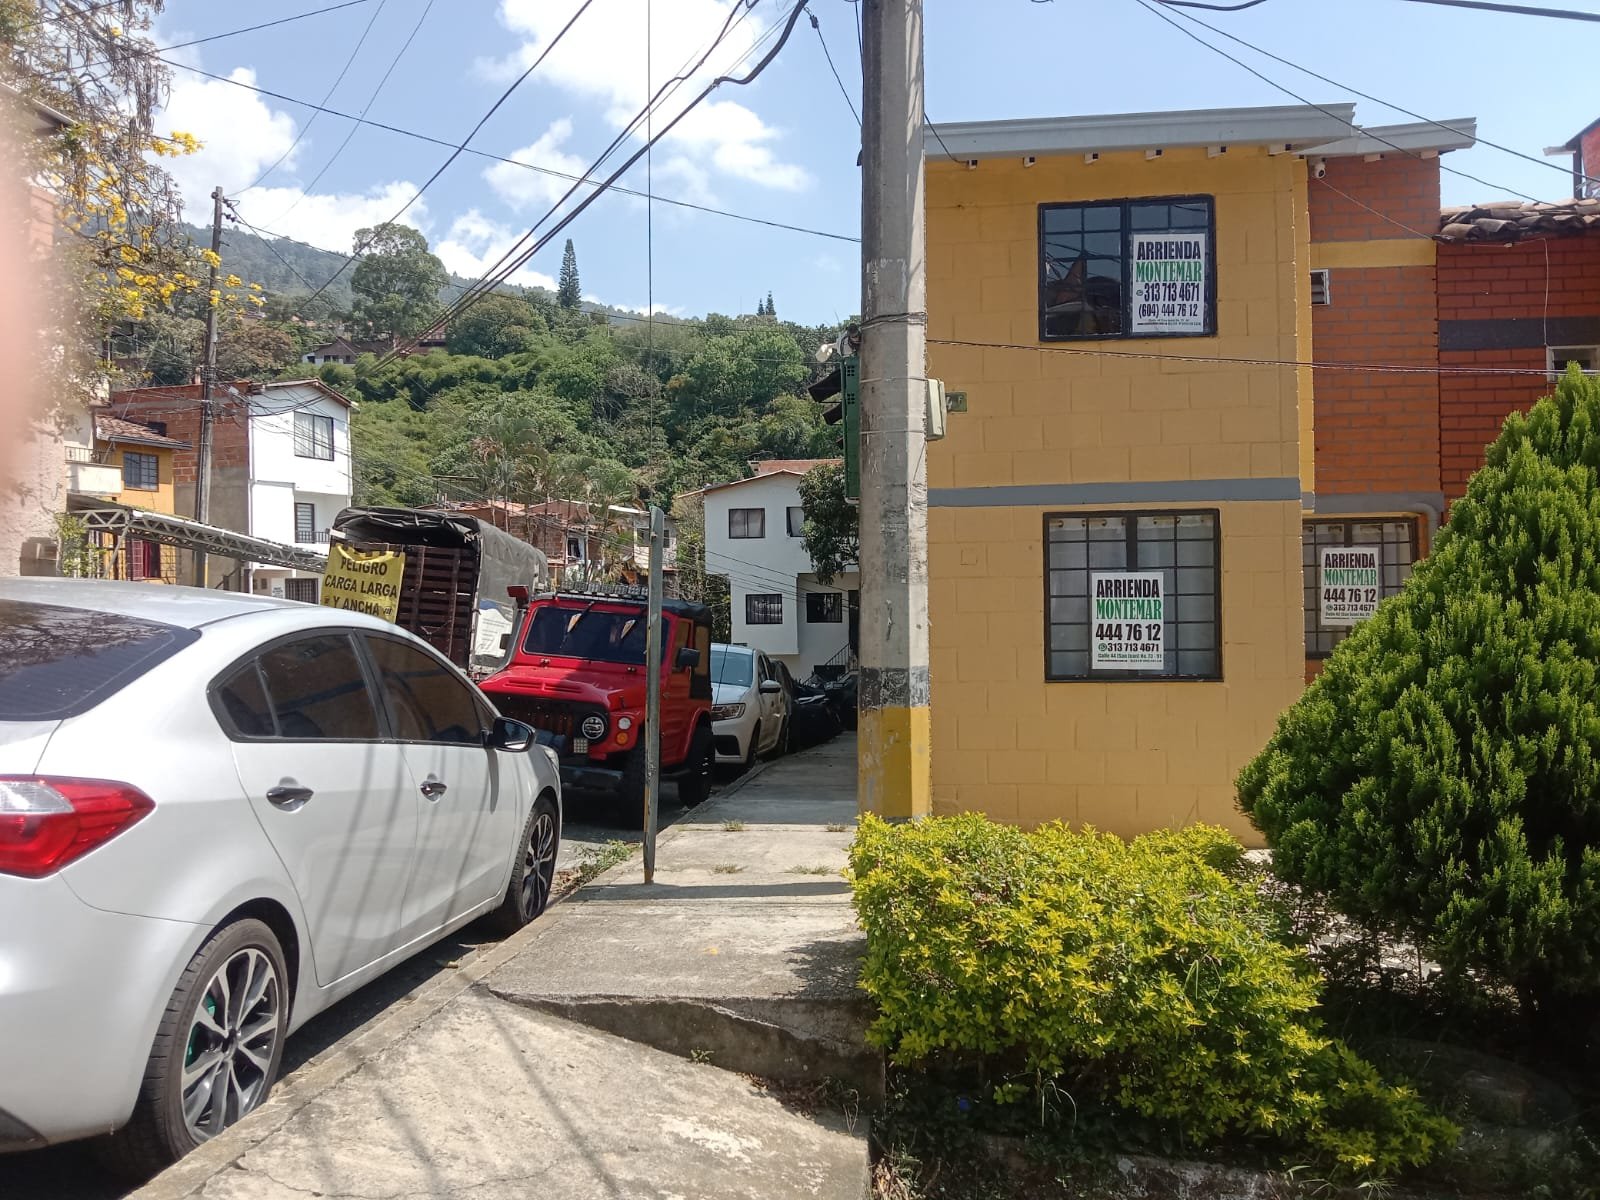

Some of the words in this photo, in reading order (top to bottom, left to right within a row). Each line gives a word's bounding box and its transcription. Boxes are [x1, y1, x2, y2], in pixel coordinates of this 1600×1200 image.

[1137, 241, 1201, 260] ARRIENDA
[1136, 261, 1202, 282] MONTEMAR
[1144, 283, 1160, 301] 313
[1162, 283, 1177, 301] 713
[1179, 283, 1200, 301] 4671
[1138, 304, 1159, 318] (604)
[1162, 304, 1175, 317] 444
[1177, 304, 1186, 317] 76
[1189, 304, 1198, 317] 12
[341, 558, 388, 576] PELIGRO
[1325, 553, 1376, 568] ARRIENDA
[324, 575, 356, 592] CARGA
[360, 580, 397, 598] LARGA
[1324, 569, 1376, 586] MONTEMAR
[1096, 579, 1160, 598] ARRIENDA
[1324, 588, 1345, 602] 444
[1348, 588, 1361, 602] 76
[1364, 588, 1376, 602] 12
[333, 596, 340, 608] Y
[342, 598, 380, 616] ANCHA
[1096, 599, 1162, 620] MONTEMAR
[1096, 624, 1122, 640] 444
[1126, 624, 1142, 640] 76
[1146, 624, 1160, 640] 12
[1108, 643, 1122, 652] 313
[1124, 643, 1138, 652] 713
[1140, 643, 1159, 652] 4671
